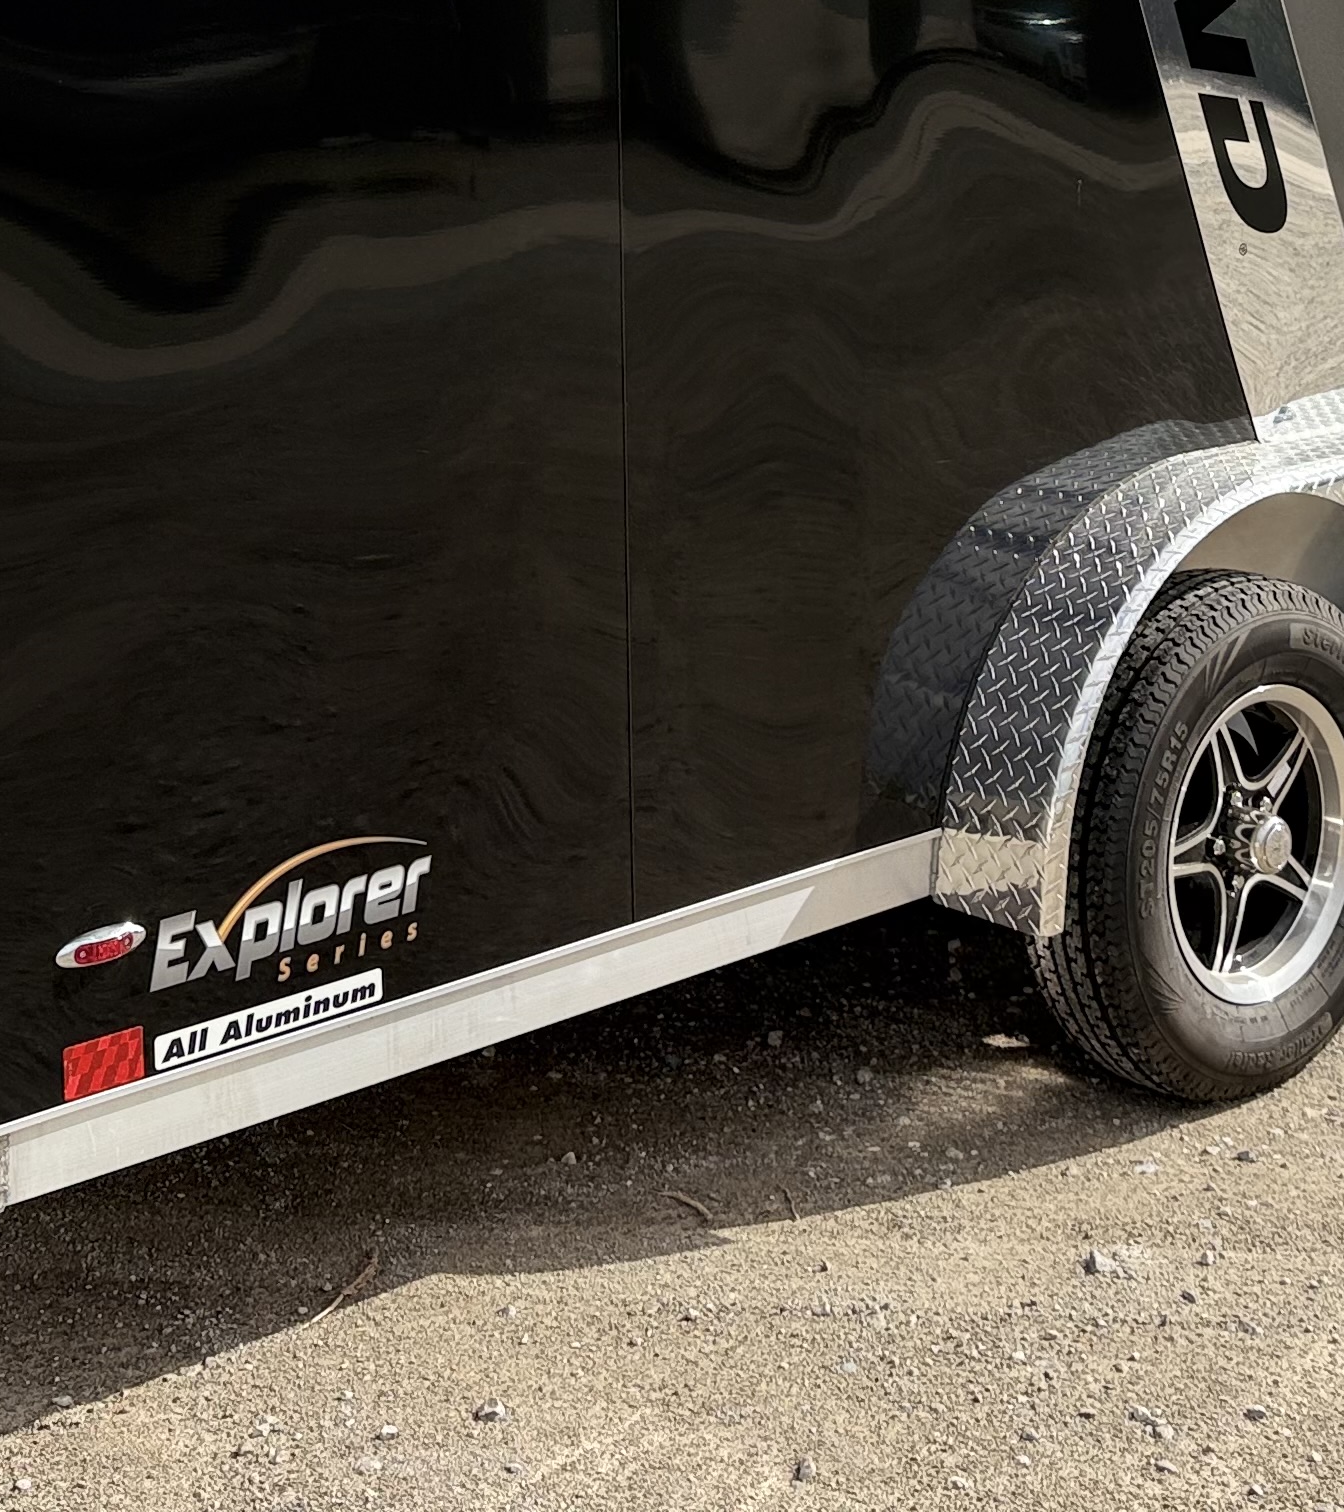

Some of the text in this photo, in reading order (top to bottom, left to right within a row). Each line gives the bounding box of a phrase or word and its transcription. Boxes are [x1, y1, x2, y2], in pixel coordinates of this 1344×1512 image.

[1138, 720, 1189, 920] ST205/75R15
[149, 854, 433, 993] Explorer
[277, 921, 418, 983] Series
[161, 981, 376, 1065] All Aluminum
